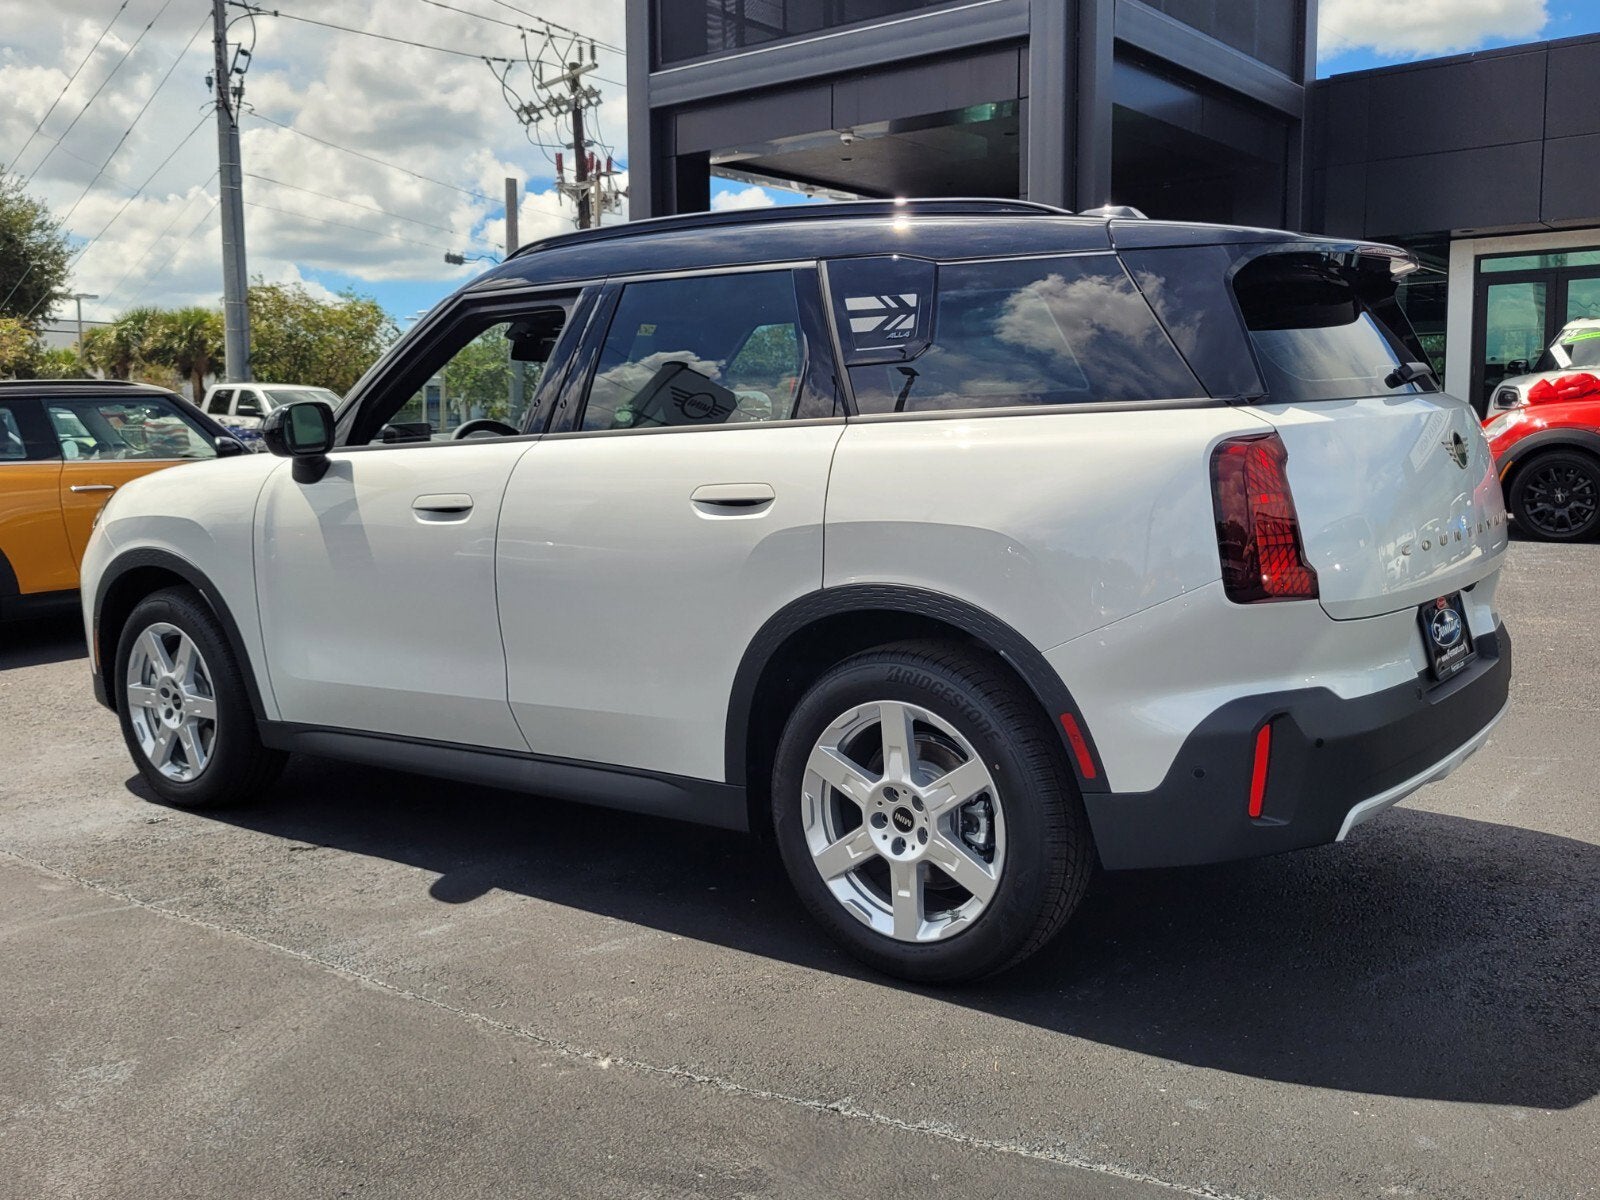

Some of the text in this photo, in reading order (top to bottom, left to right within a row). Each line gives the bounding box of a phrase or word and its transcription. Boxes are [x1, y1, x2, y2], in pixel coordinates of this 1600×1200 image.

[886, 331, 911, 339] ALL4
[885, 664, 1003, 744] BRIDGESTONE
[894, 812, 913, 827] MINI
